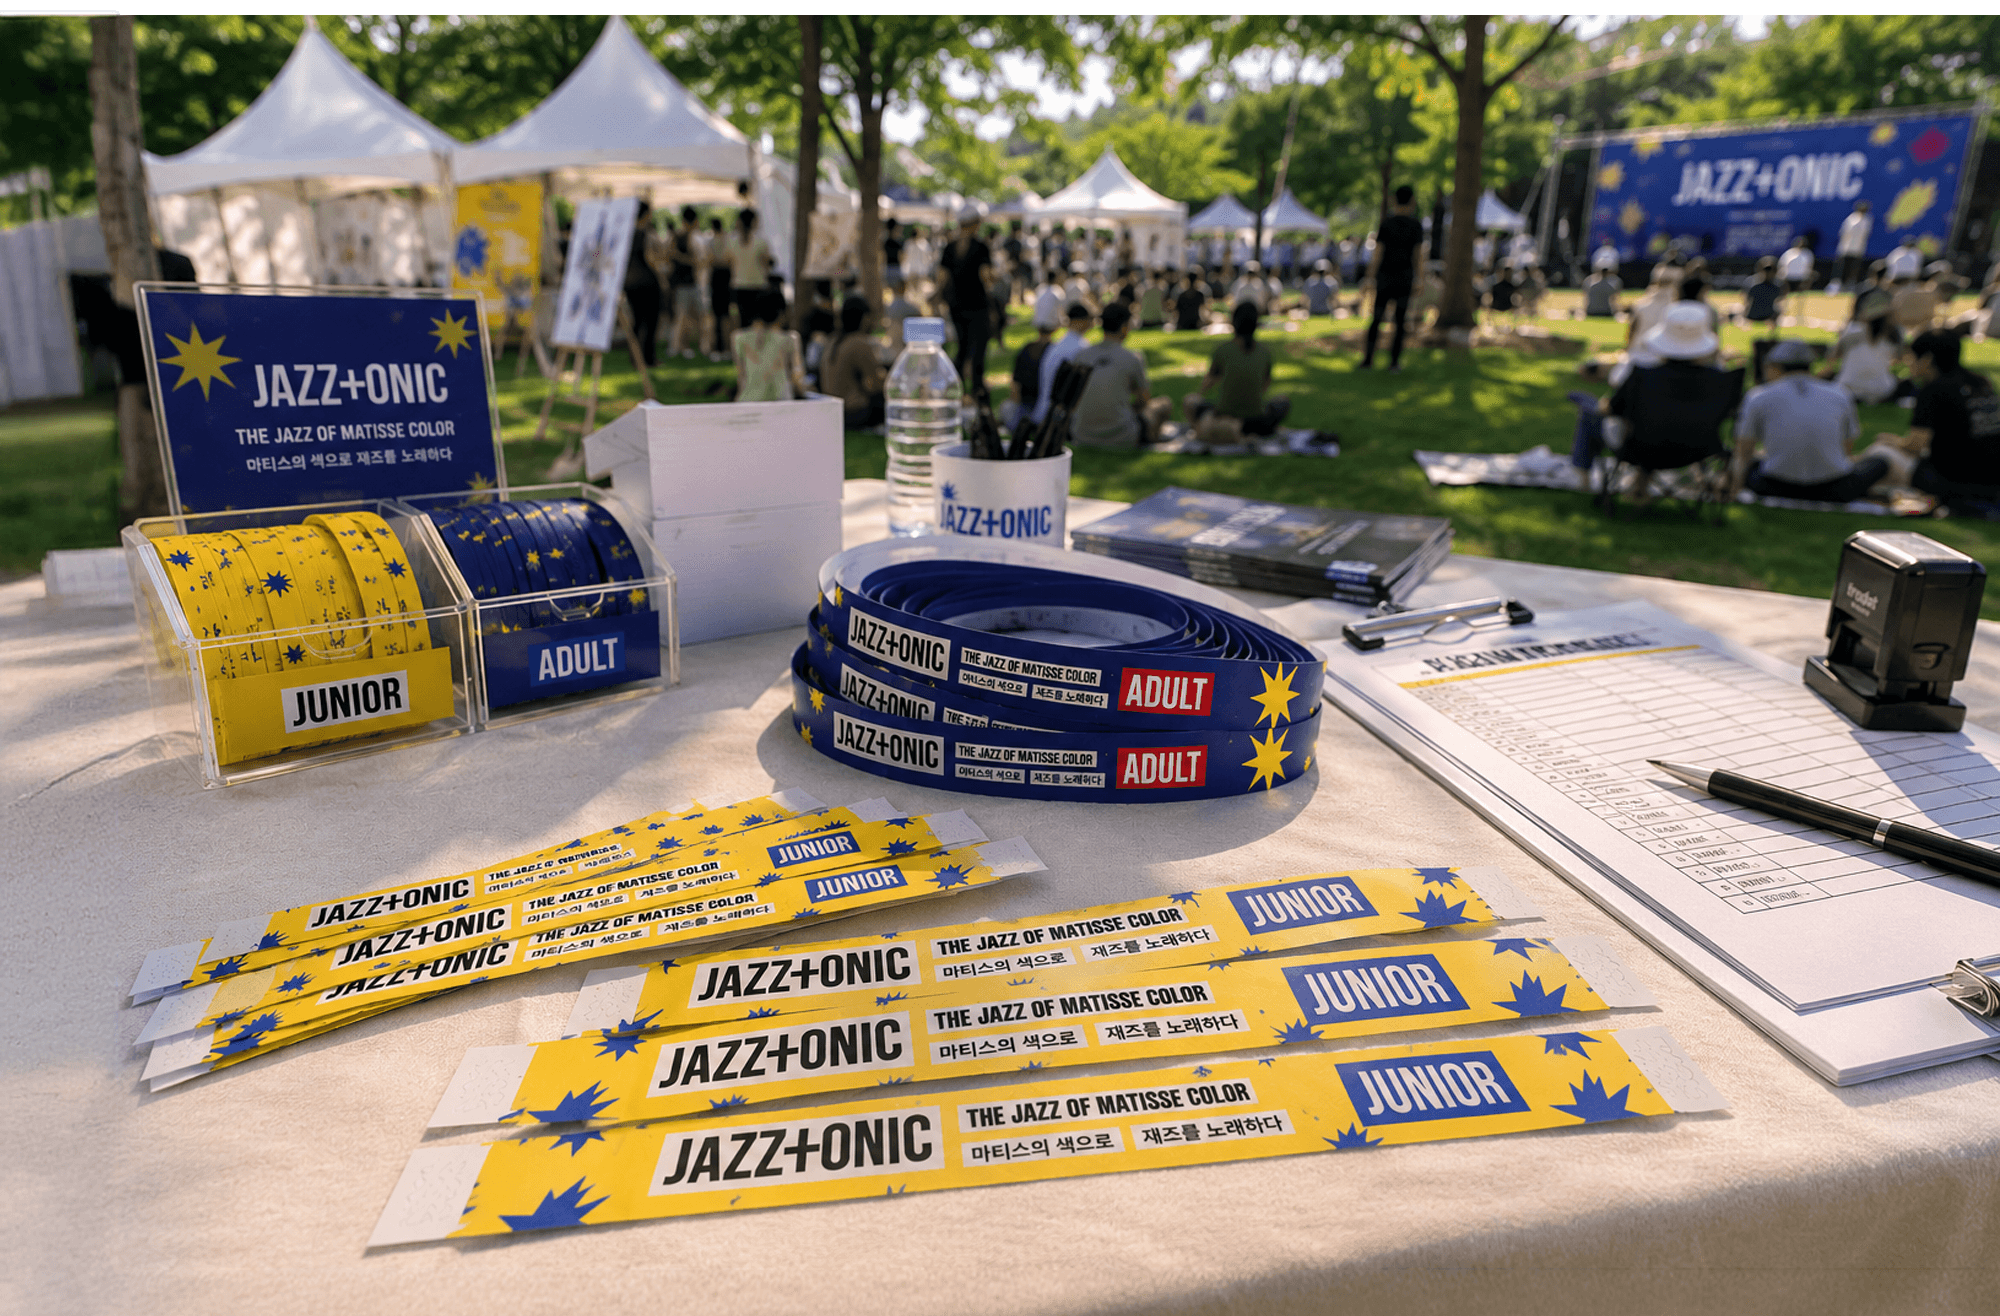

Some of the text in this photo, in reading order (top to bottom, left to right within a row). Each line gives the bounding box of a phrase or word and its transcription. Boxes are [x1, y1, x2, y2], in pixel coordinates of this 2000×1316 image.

[1672, 150, 1867, 206] JAZZ+ONIC
[253, 363, 449, 408] JAZZ+ONIC
[235, 420, 456, 445] THE JAZZ OF MATISSE COLOR
[940, 502, 1052, 539] JAZZ+ONIC
[538, 637, 618, 681] ADULT
[850, 615, 945, 672] JAZZ+ONIC
[964, 650, 1097, 685] THE JAZZ OF MATISSE COLOR
[293, 677, 402, 727] JUNIOR
[1125, 674, 1208, 710] ADULT
[836, 718, 939, 769] JAZZ+ONIC
[959, 745, 1093, 765] THE JAZZ OF MATISSE COLOR
[1123, 751, 1201, 784] ADULT
[779, 835, 853, 864] JUNIOR
[311, 879, 469, 928] JAZZ+ONIC
[559, 888, 594, 903] JAZZ
[678, 861, 719, 878] COLOR
[816, 868, 899, 899] JUNIOR
[537, 928, 565, 943] THE
[570, 919, 609, 937] JAZZ
[613, 915, 634, 929] OF
[637, 902, 706, 924] MATISSE
[1245, 883, 1364, 927] JUNIOR
[338, 908, 505, 966] JAZZ+ONIC
[938, 908, 1183, 956] THE JAZZ OF MATISSE COLOR
[943, 928, 1210, 979] 마티스의 색으로 재즈를 노래하다
[697, 947, 911, 1001] JAZZ+ONIC
[1304, 963, 1451, 1015] JUNIOR
[934, 984, 1208, 1030] THE JAZZ OF MATISSE COLOR
[659, 1019, 903, 1089] JAZZ+ONIC
[940, 1014, 1239, 1059] 마티스의 색으로 재즈를 노래하다
[966, 1083, 1251, 1128] THE JAZZ OF MATISSE COLOR
[1358, 1061, 1511, 1115] JUNIOR
[663, 1114, 932, 1186] JAZZ+ONIC
[971, 1115, 1282, 1162] 마티스의 색으로 재즈를 노래하다
